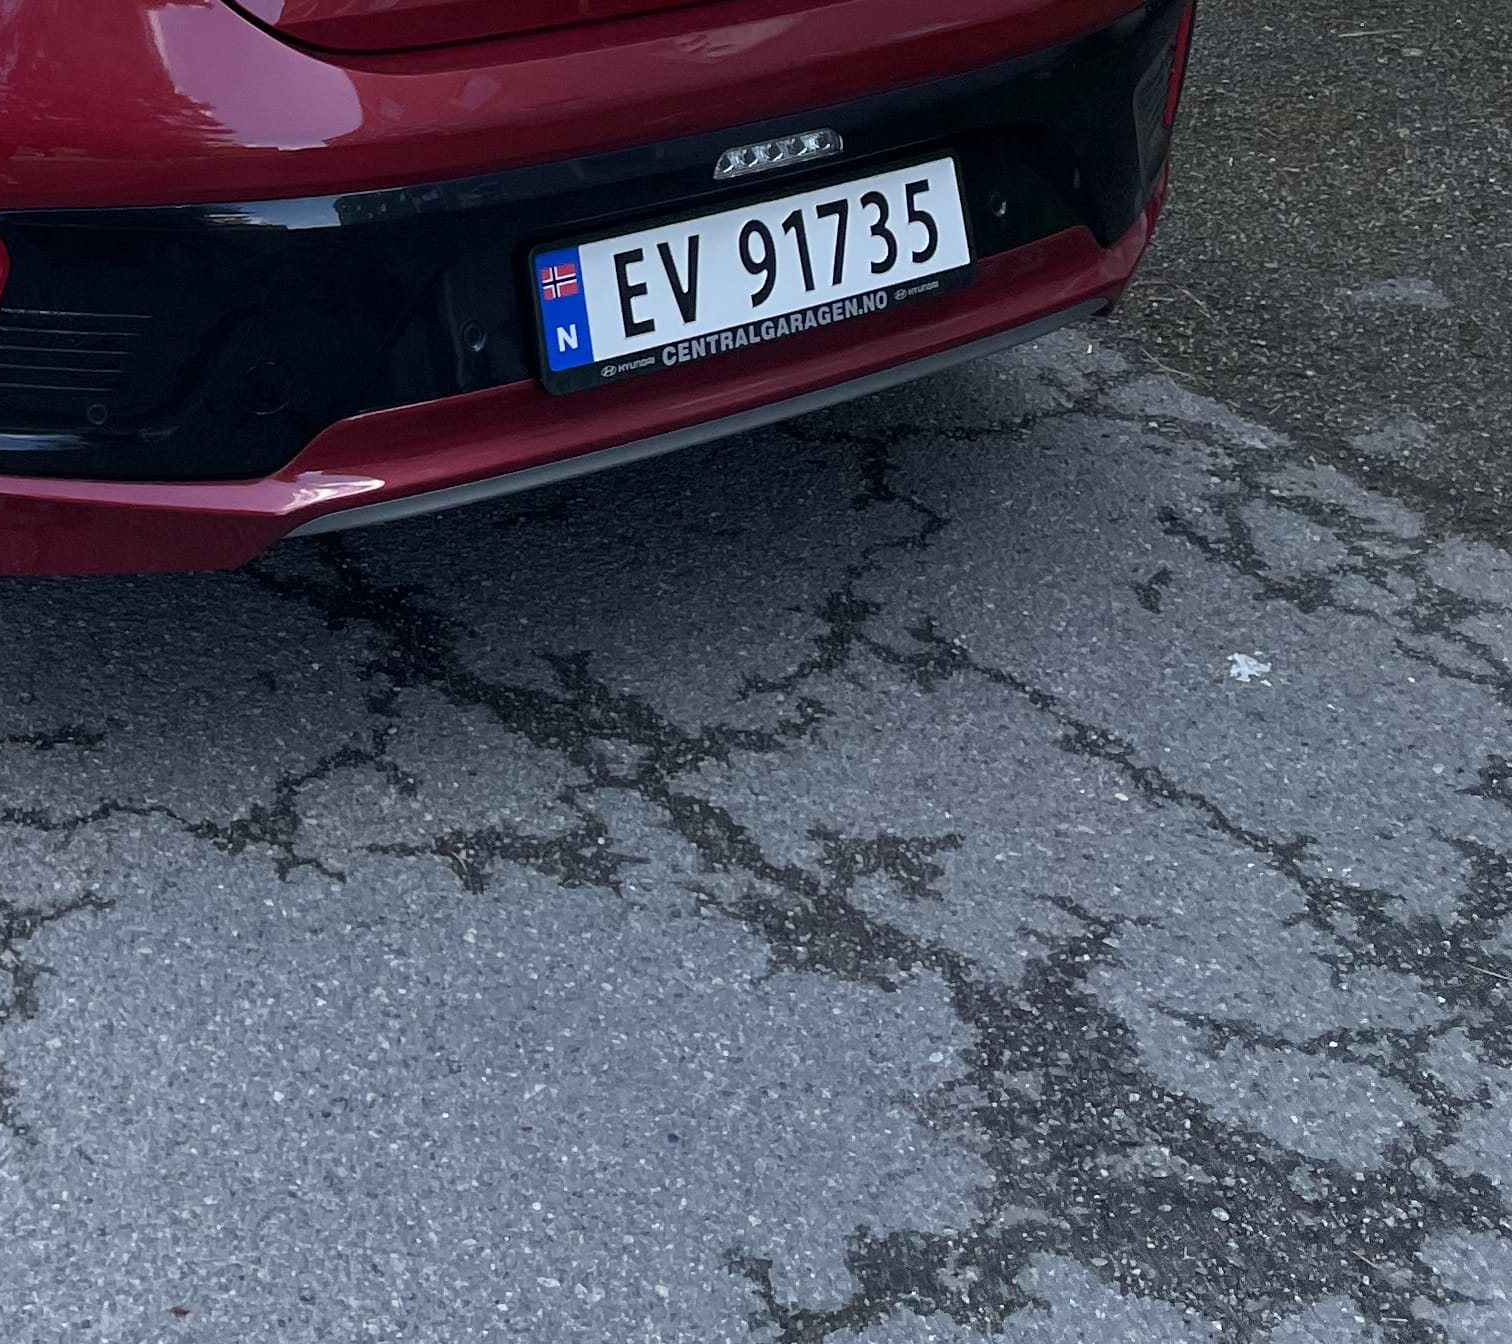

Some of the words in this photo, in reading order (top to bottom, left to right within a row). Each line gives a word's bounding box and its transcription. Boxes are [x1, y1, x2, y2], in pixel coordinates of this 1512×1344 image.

[613, 234, 700, 339] EV
[738, 178, 939, 309] 91735
[556, 324, 579, 353] N
[661, 290, 888, 367] CENTRALGARAGEN.NO
